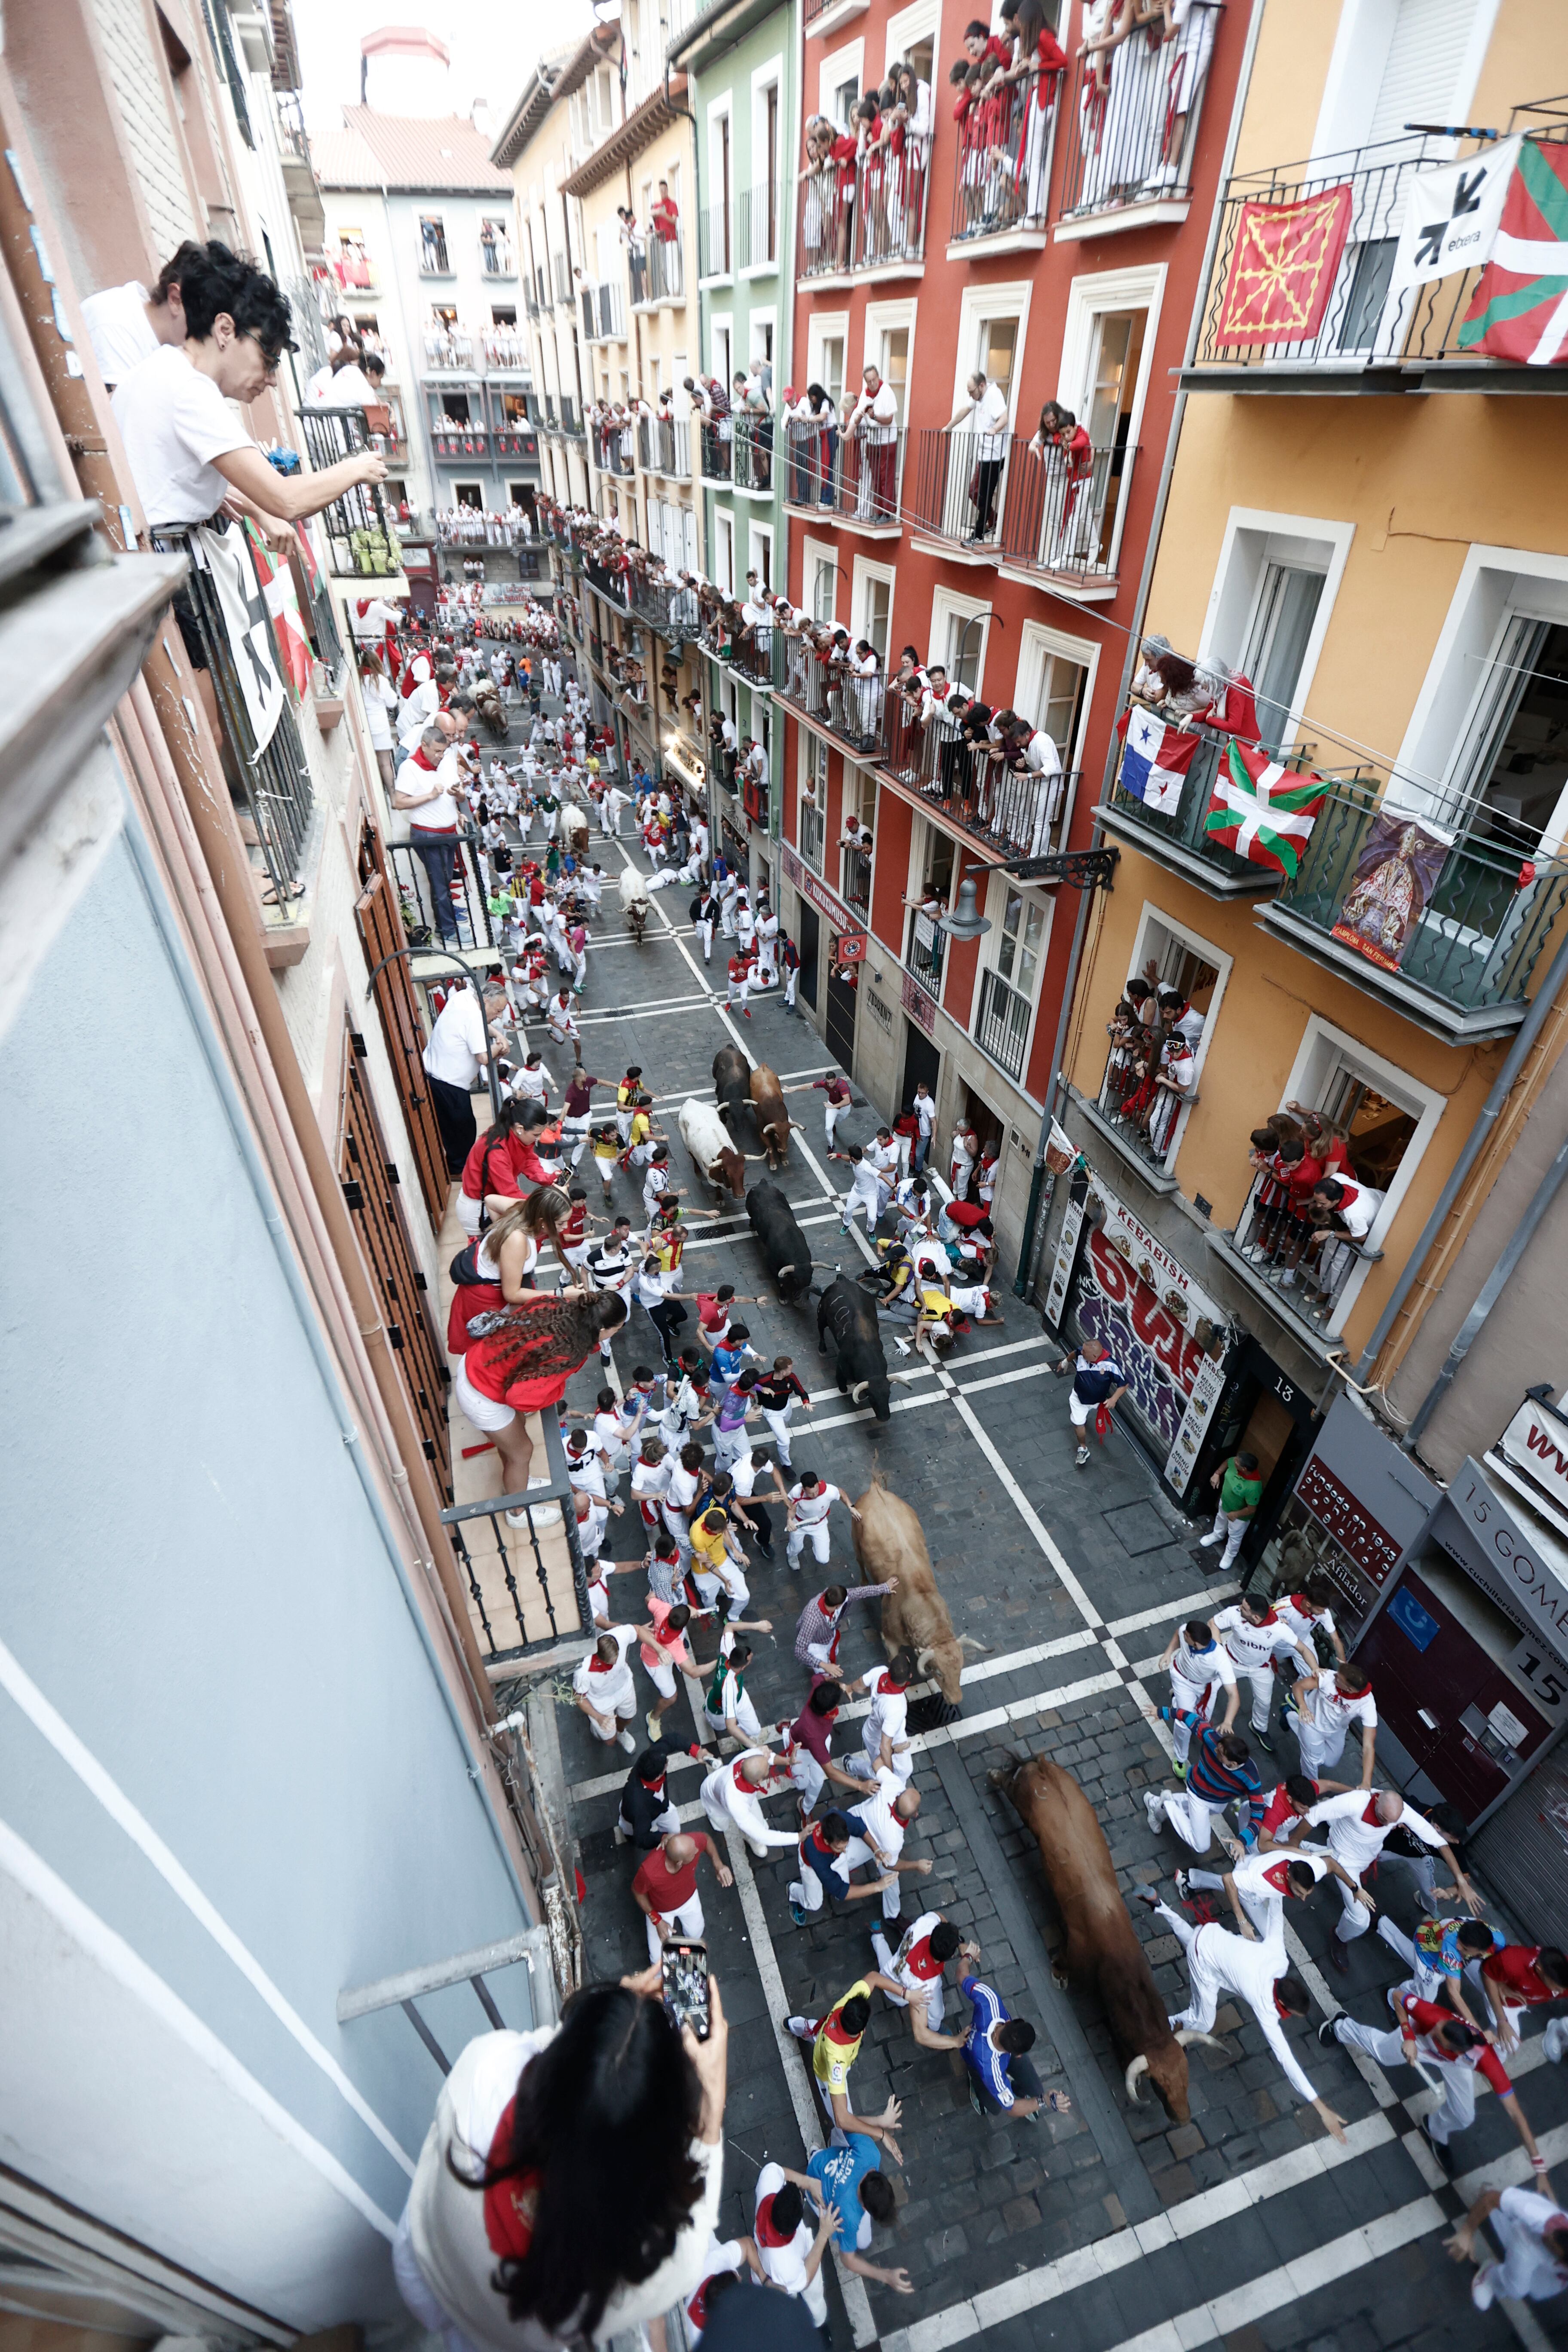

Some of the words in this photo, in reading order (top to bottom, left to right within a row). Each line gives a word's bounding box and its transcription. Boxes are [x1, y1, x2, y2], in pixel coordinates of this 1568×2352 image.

[1448, 231, 1481, 252] etxera
[812, 882, 847, 930] KUKUXUMUSU
[1335, 926, 1359, 946] PAMPLONA
[1362, 943, 1374, 955] SAN
[867, 988, 891, 1032] ZARRANZ
[1022, 1144, 1030, 1158] 9-11
[1069, 1200, 1082, 1218] KEBAB
[1066, 1221, 1077, 1235] BASMATI
[1068, 1219, 1077, 1229] ARROZ
[1069, 1214, 1077, 1225] PLATO
[1061, 1248, 1070, 1261] FRITAS
[1118, 1206, 1188, 1290] KEBABISH
[1055, 1274, 1065, 1286] KEBAB
[1056, 1270, 1066, 1282] PLATO
[1050, 1298, 1059, 1310] ASADO
[1051, 1295, 1060, 1307] POLLO
[717, 1304, 729, 1318] NIKE
[1204, 1358, 1223, 1382] KEB
[1197, 1383, 1213, 1404] FALAFEL
[1200, 1381, 1214, 1397] KEBAB
[1201, 1375, 1216, 1393] MENÚ
[1274, 1376, 1294, 1402] 13
[1185, 1419, 1200, 1439] KEBAB
[1188, 1414, 1203, 1433] MENÚ
[1175, 1450, 1189, 1469] MENÚ
[1464, 1482, 1491, 1523] 15
[1332, 1550, 1339, 1560] De
[1371, 1532, 1396, 1561] 1943
[1327, 1559, 1367, 1605] Afilador
[1518, 1652, 1568, 1706] 15
